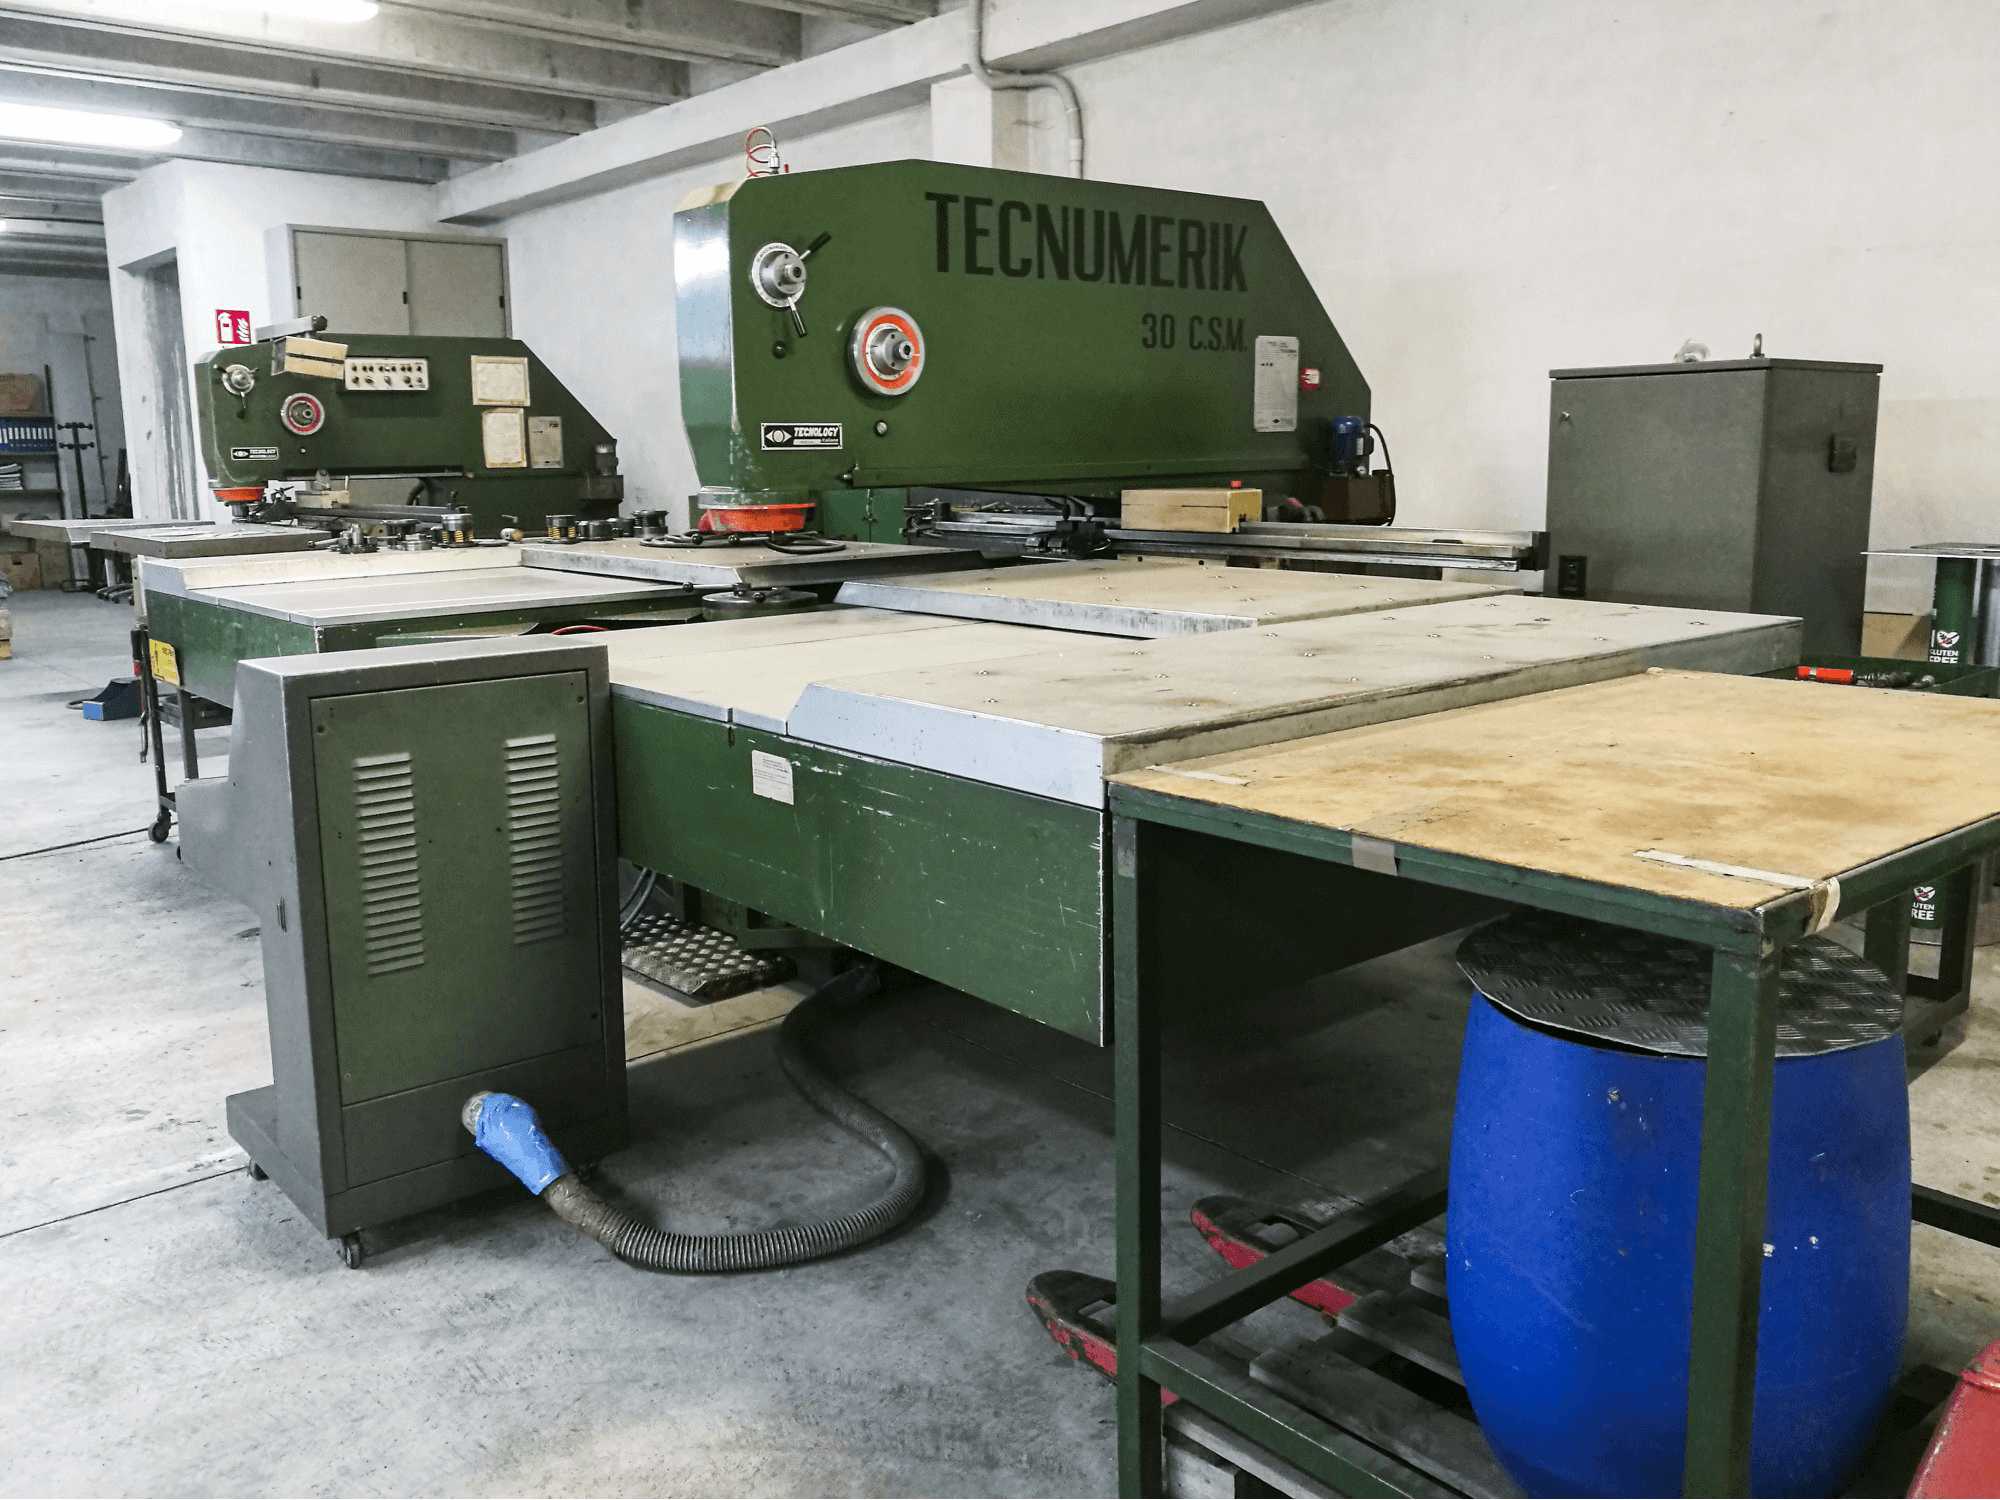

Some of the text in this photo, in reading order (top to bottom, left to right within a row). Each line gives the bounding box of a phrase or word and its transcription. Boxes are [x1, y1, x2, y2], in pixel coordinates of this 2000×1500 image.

[924, 191, 1248, 293] TECNUMERIK
[1141, 312, 1176, 350] 30
[1189, 315, 1248, 352] C.S.M.
[793, 426, 839, 437] TECNOLOGY
[1911, 908, 1935, 921] REE
